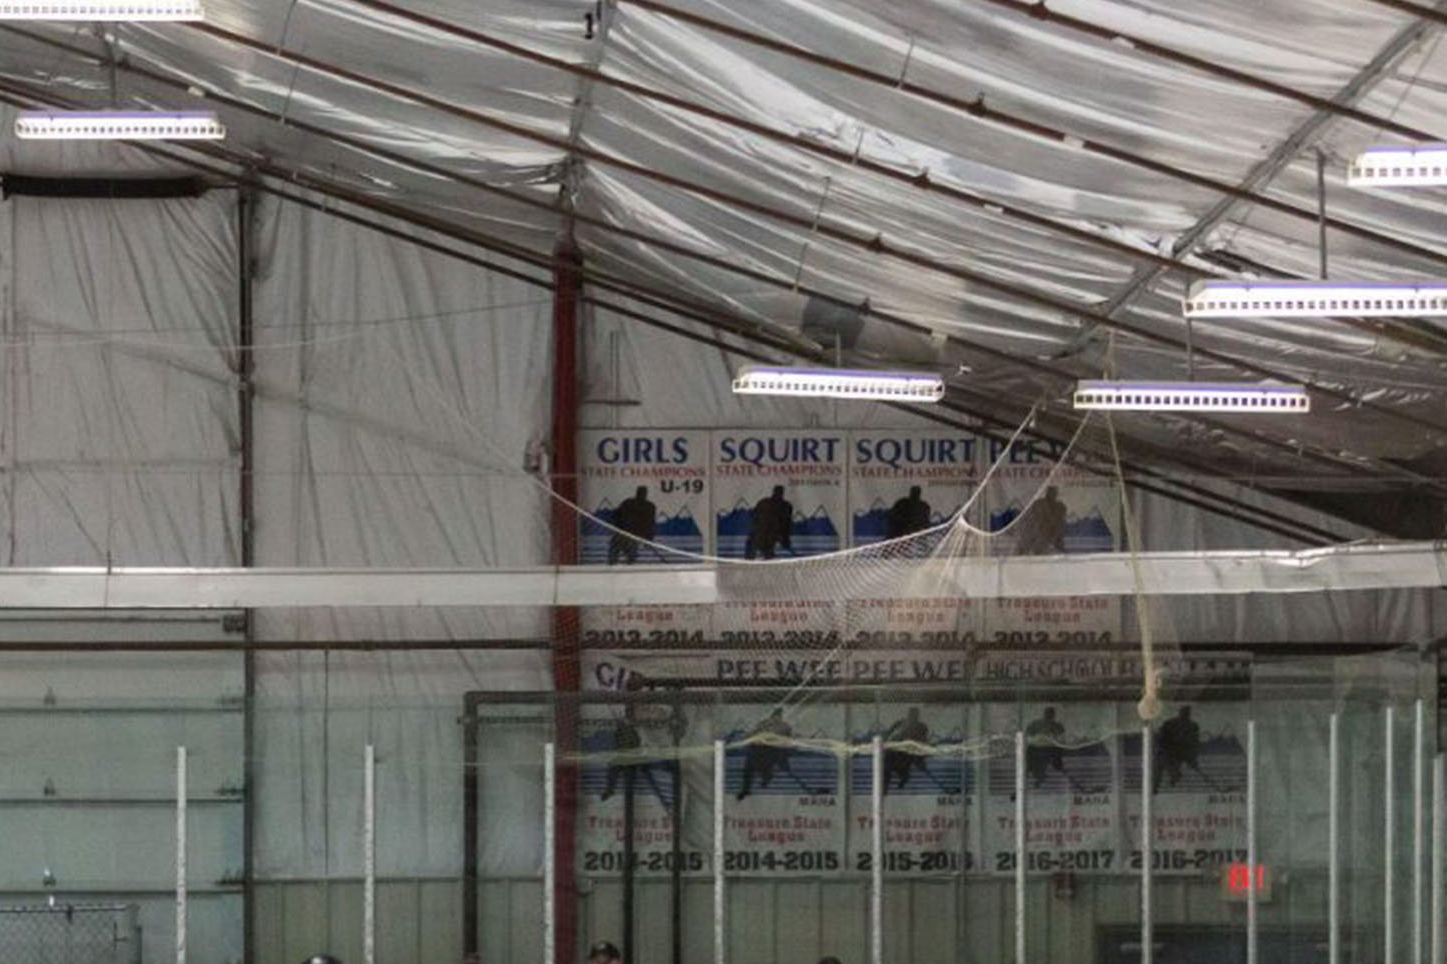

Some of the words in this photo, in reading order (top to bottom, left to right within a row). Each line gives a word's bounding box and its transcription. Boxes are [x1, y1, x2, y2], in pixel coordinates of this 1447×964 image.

[597, 437, 689, 465] GIRLS
[719, 437, 841, 468] SQUIRT
[856, 438, 977, 469] SQUIRT
[620, 466, 706, 478] CHAMPIONS
[716, 464, 755, 477] STATE
[757, 464, 843, 477] CHAMPIONS
[855, 467, 893, 478] STATE
[660, 479, 704, 494] U-19
[616, 607, 674, 624] League
[723, 851, 839, 871] 2014-2015
